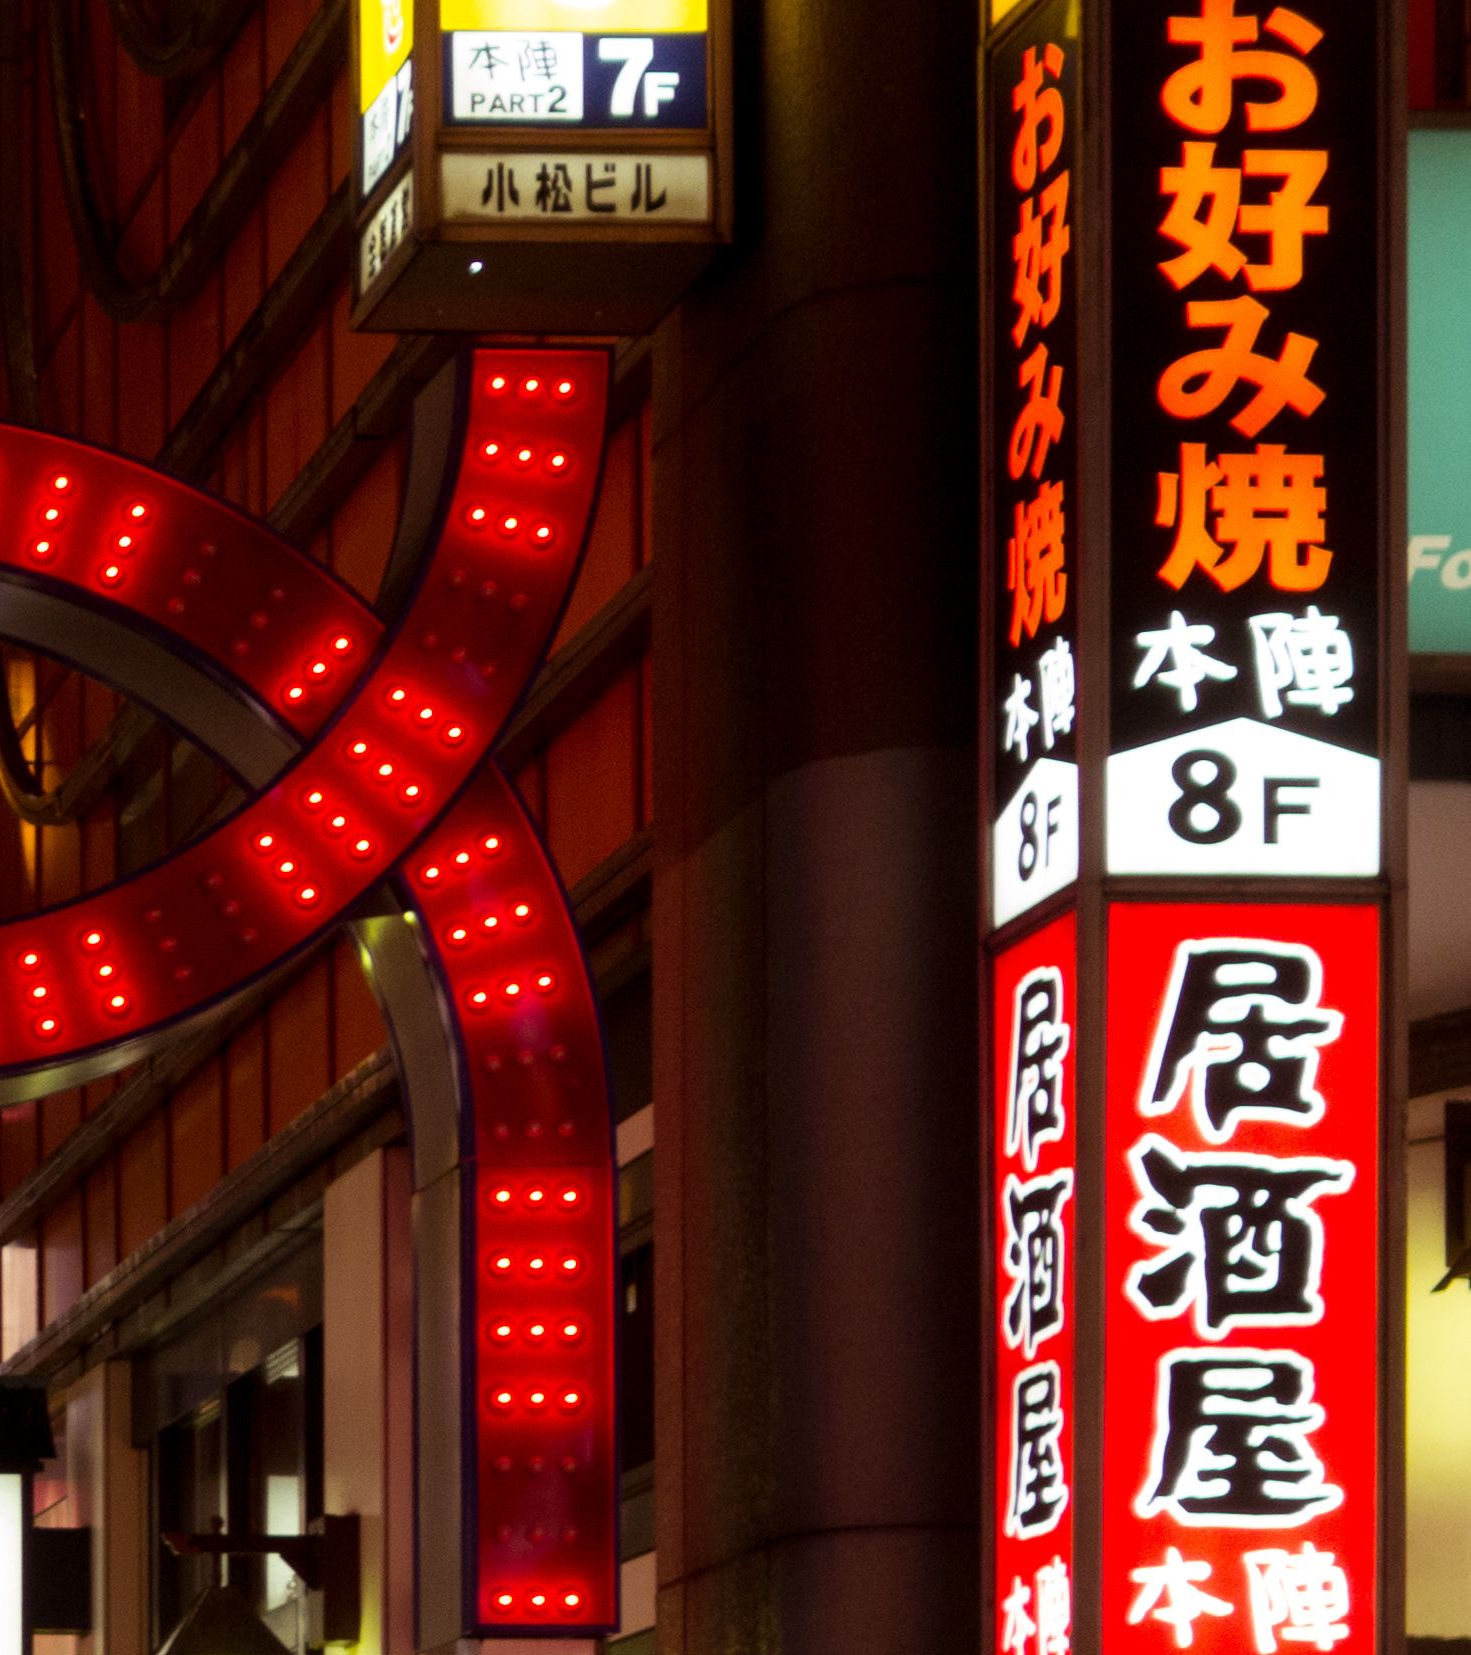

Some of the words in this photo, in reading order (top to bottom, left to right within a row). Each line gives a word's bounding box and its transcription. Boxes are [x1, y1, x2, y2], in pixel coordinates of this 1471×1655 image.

[598, 37, 680, 117] 7F
[481, 163, 666, 213] 小松ビル
[1008, 43, 1070, 647] お好み焼
[1156, 0, 1333, 592] お好み焼
[1133, 605, 1355, 717] 本陣
[1018, 790, 1062, 882] 8F
[1167, 748, 1321, 845] 8F
[1004, 966, 1070, 1540] 居酒屋
[1125, 935, 1358, 1527] 居酒屋
[1126, 1541, 1351, 1655] 本陣
